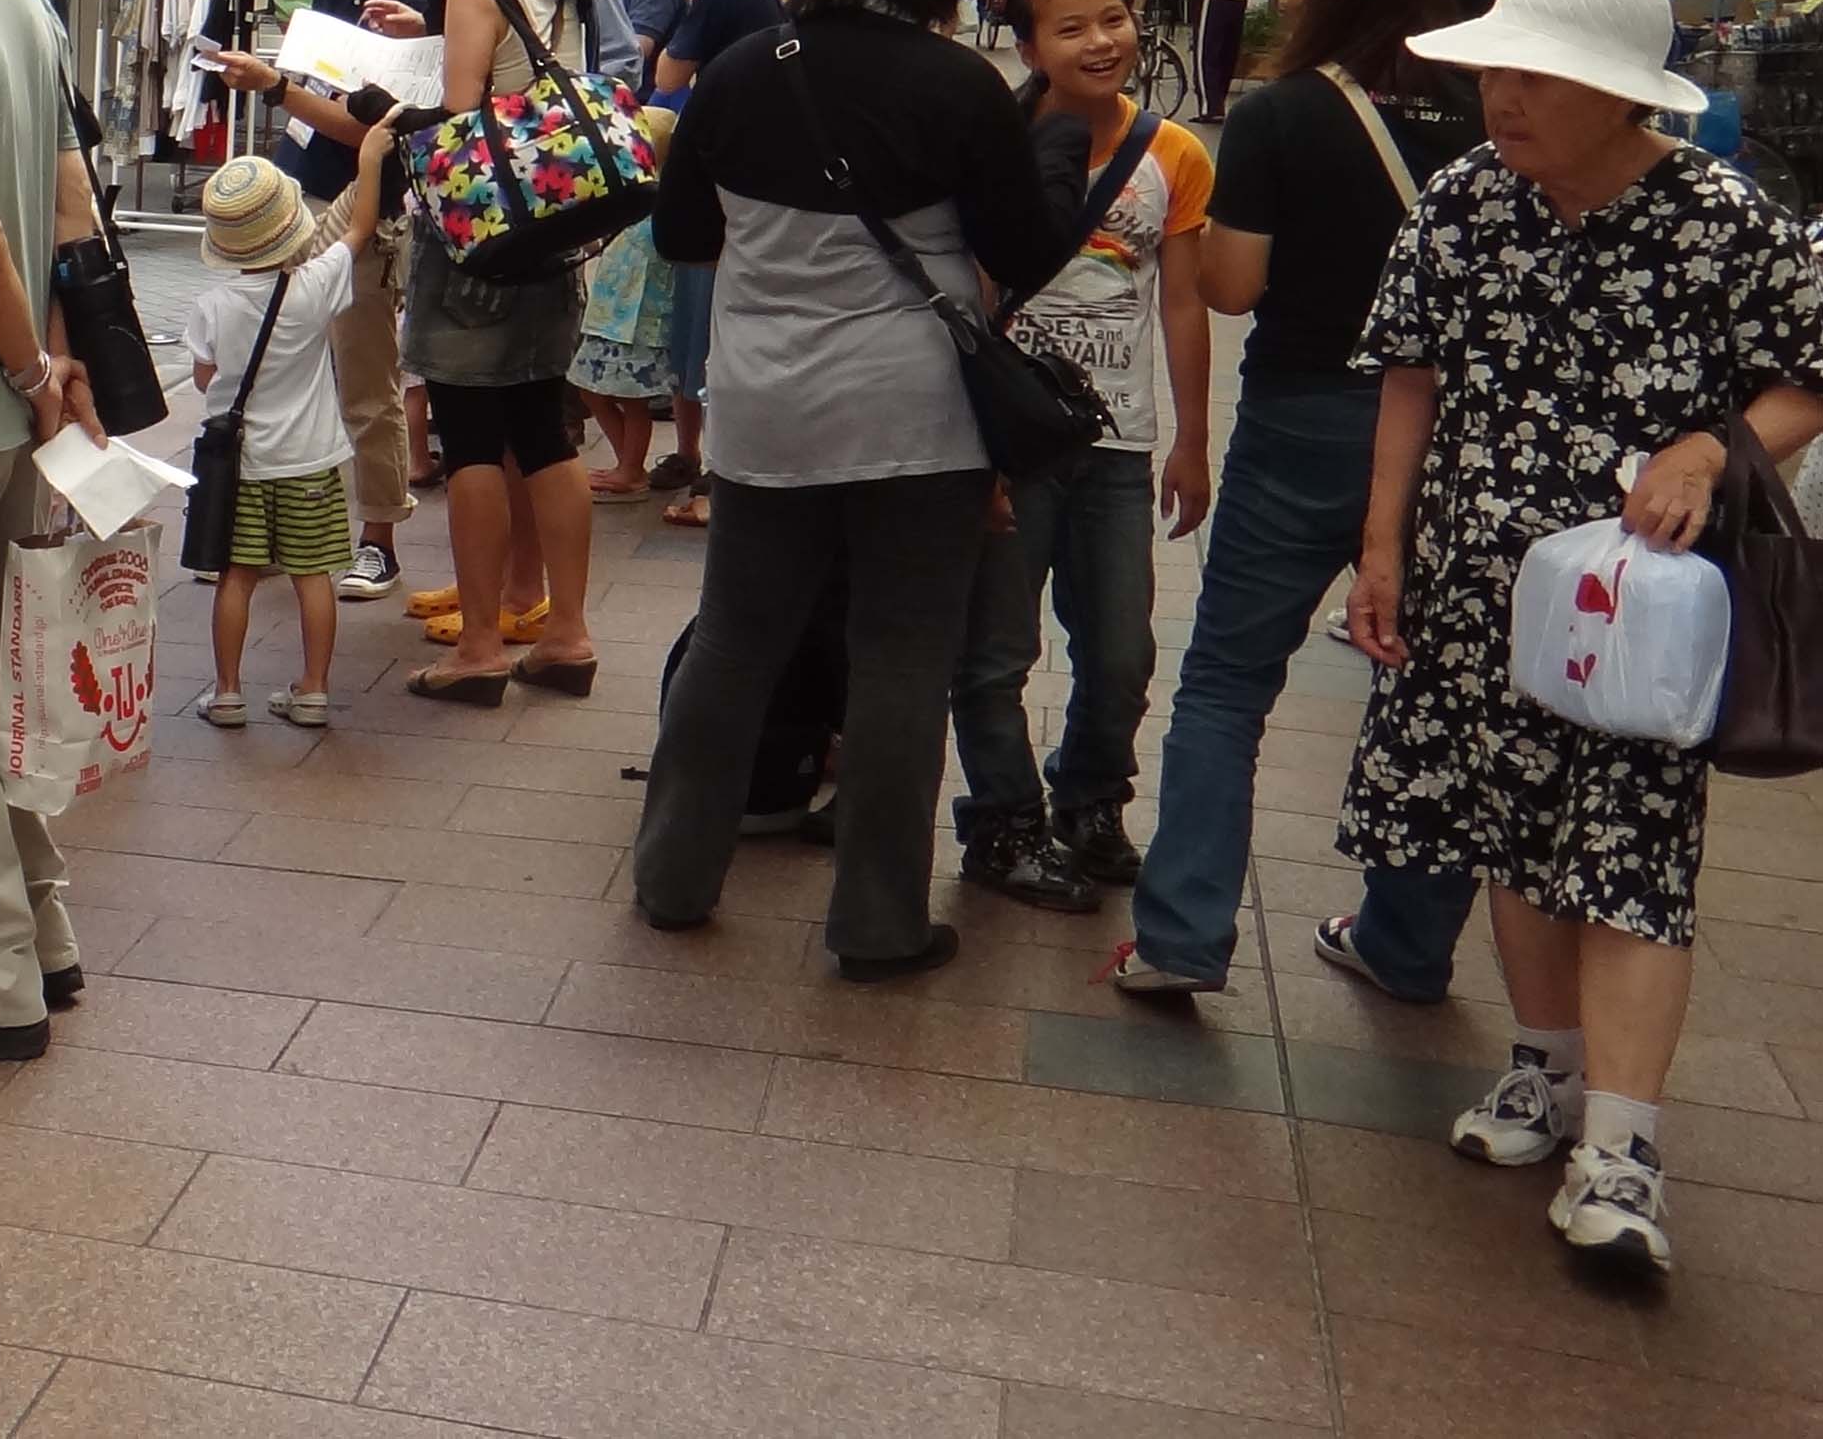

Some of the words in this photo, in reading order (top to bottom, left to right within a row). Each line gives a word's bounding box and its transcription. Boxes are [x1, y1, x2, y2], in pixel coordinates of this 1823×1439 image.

[1094, 328, 1124, 342] and
[8, 574, 24, 683] STANDARD
[8, 690, 26, 779] JOURNAL
